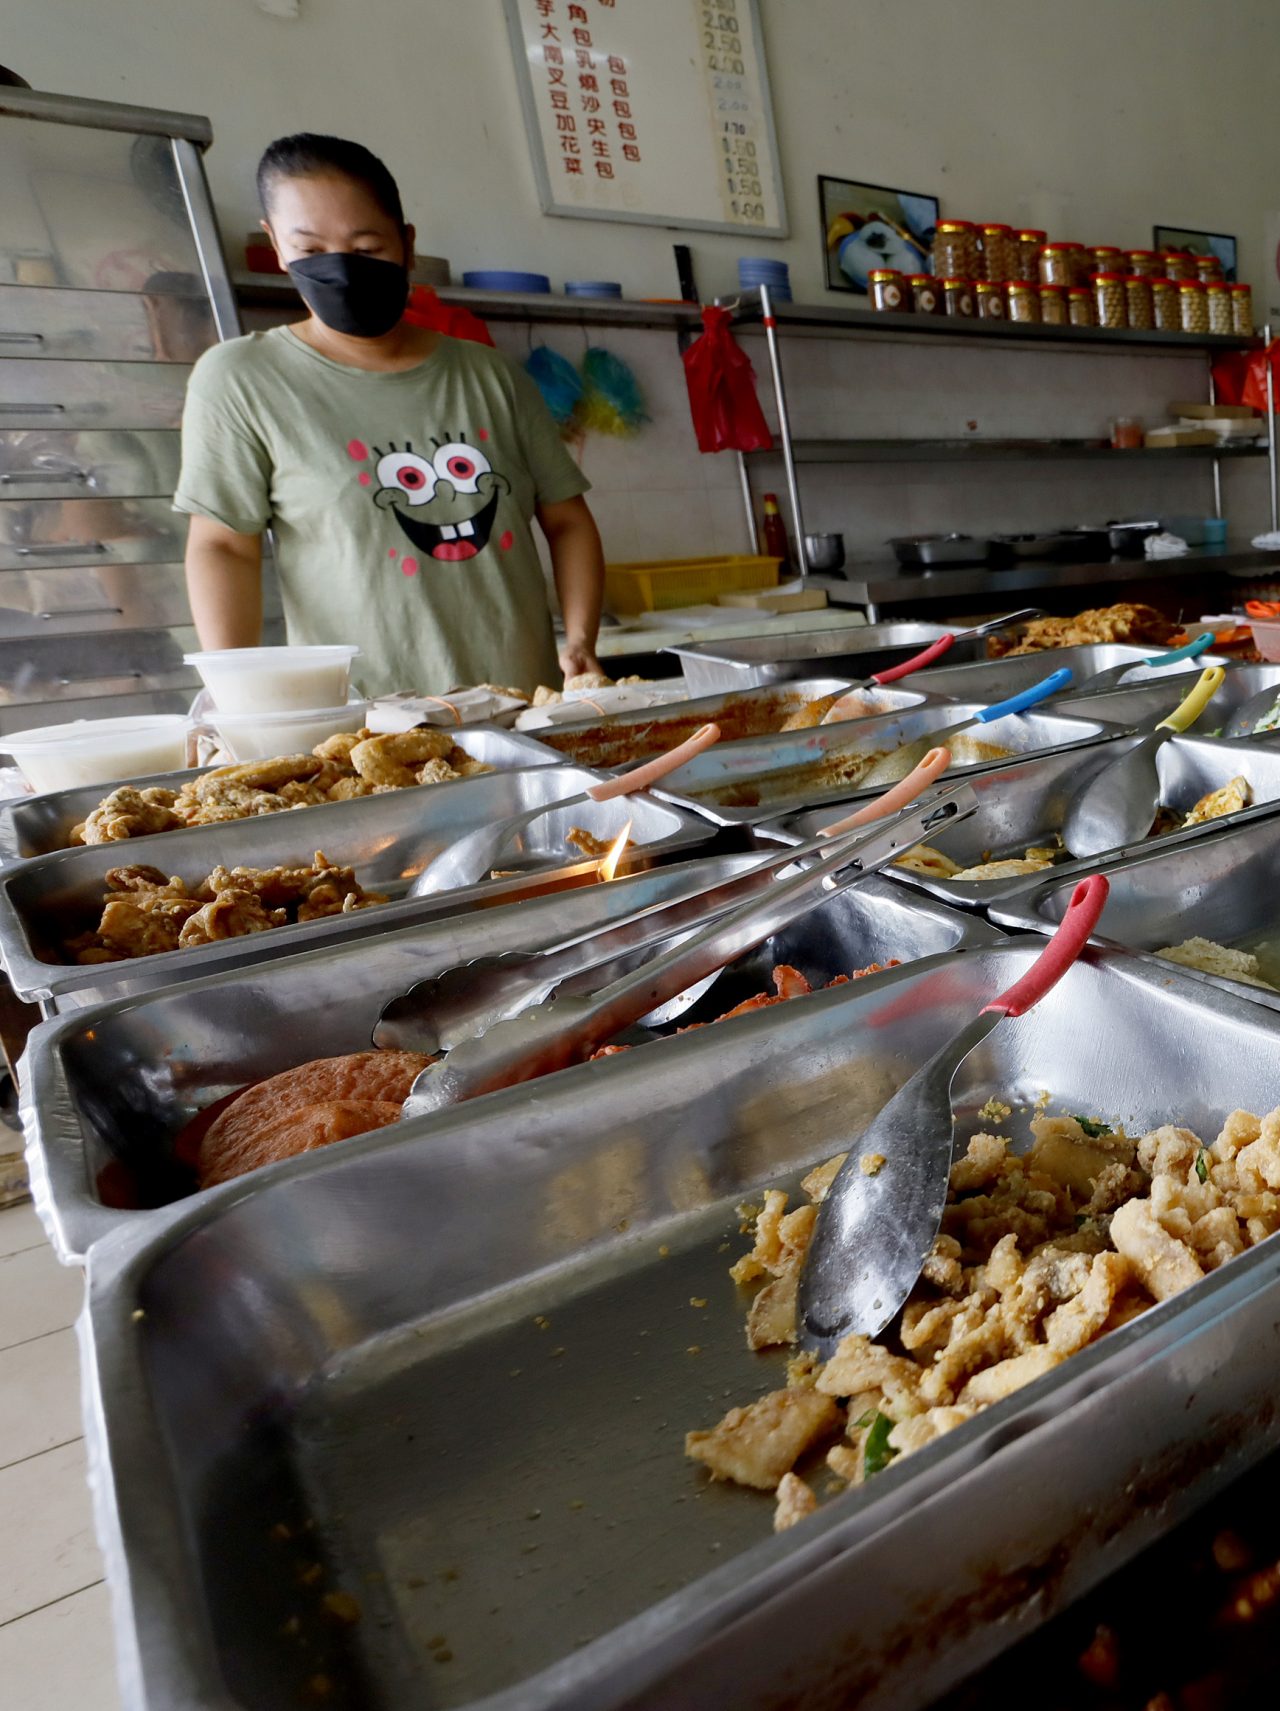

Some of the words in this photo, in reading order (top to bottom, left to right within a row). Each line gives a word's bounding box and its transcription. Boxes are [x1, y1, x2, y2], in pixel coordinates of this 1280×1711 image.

[540, 22, 593, 47] 大包
[549, 90, 632, 118] 豆沙包
[556, 114, 637, 140] 加央包
[560, 135, 641, 162] 花生包
